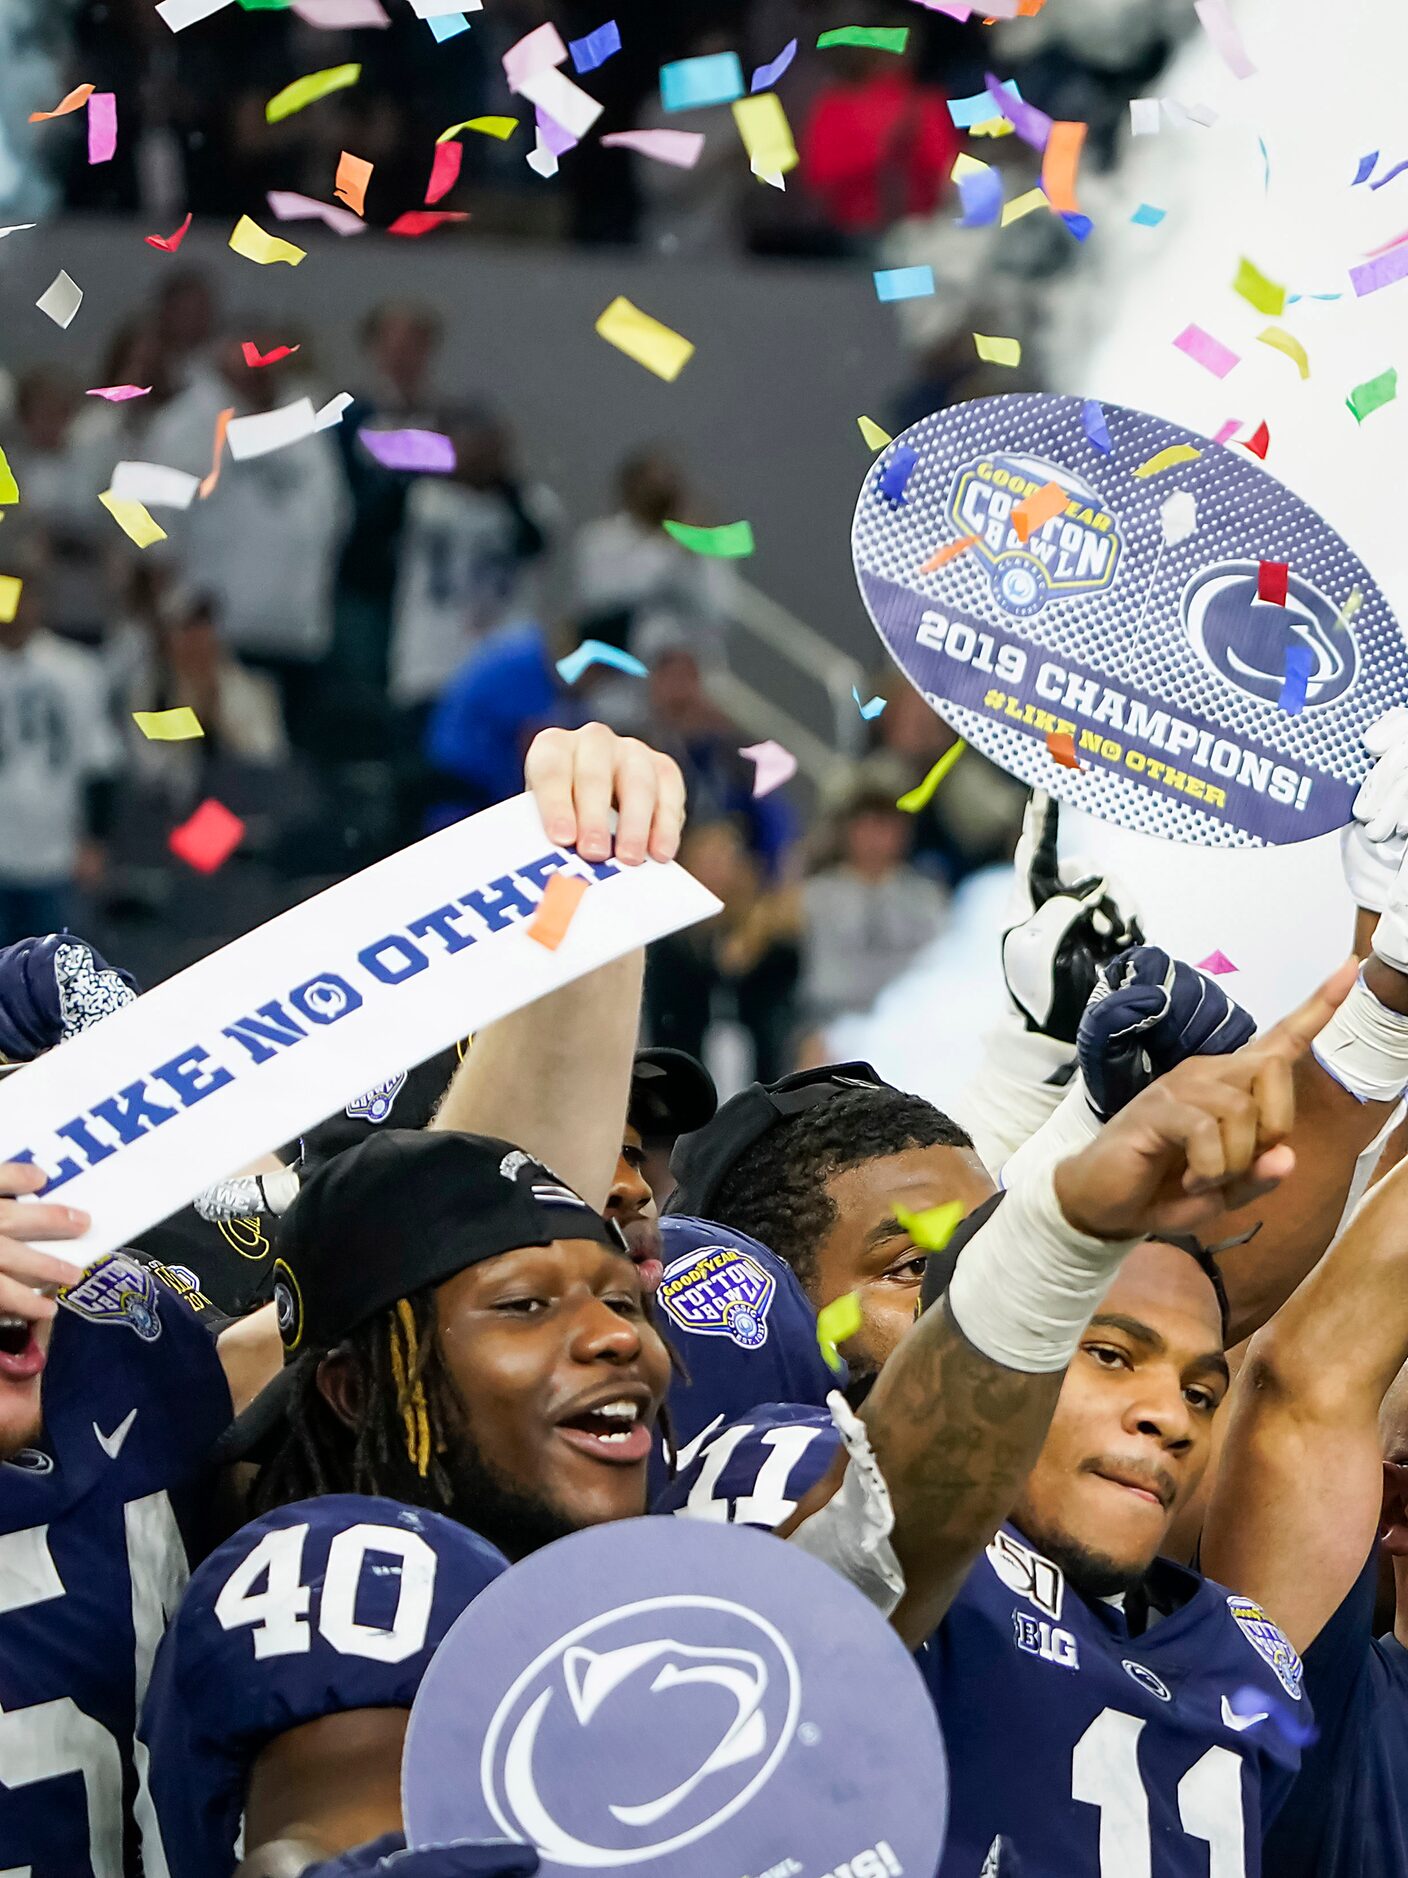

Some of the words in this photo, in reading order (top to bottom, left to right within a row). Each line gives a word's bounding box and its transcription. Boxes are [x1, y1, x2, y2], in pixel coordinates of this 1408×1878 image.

[962, 480, 1111, 577] COTON
[976, 462, 1112, 532] GOODEAR
[915, 610, 1027, 684] 2019
[1035, 661, 1312, 811] CHAMPIONS!
[1079, 731, 1122, 763] NO
[1125, 750, 1227, 809] OTHER
[5, 1044, 236, 1198] LIKE
[221, 971, 364, 1065] NO
[661, 1251, 739, 1297] GOODYEAR
[671, 1260, 766, 1320] COTTON
[699, 1281, 759, 1320] BOWL
[673, 1424, 822, 1528] 11
[214, 1522, 438, 1664] 40
[1072, 1706, 1247, 1878] 11
